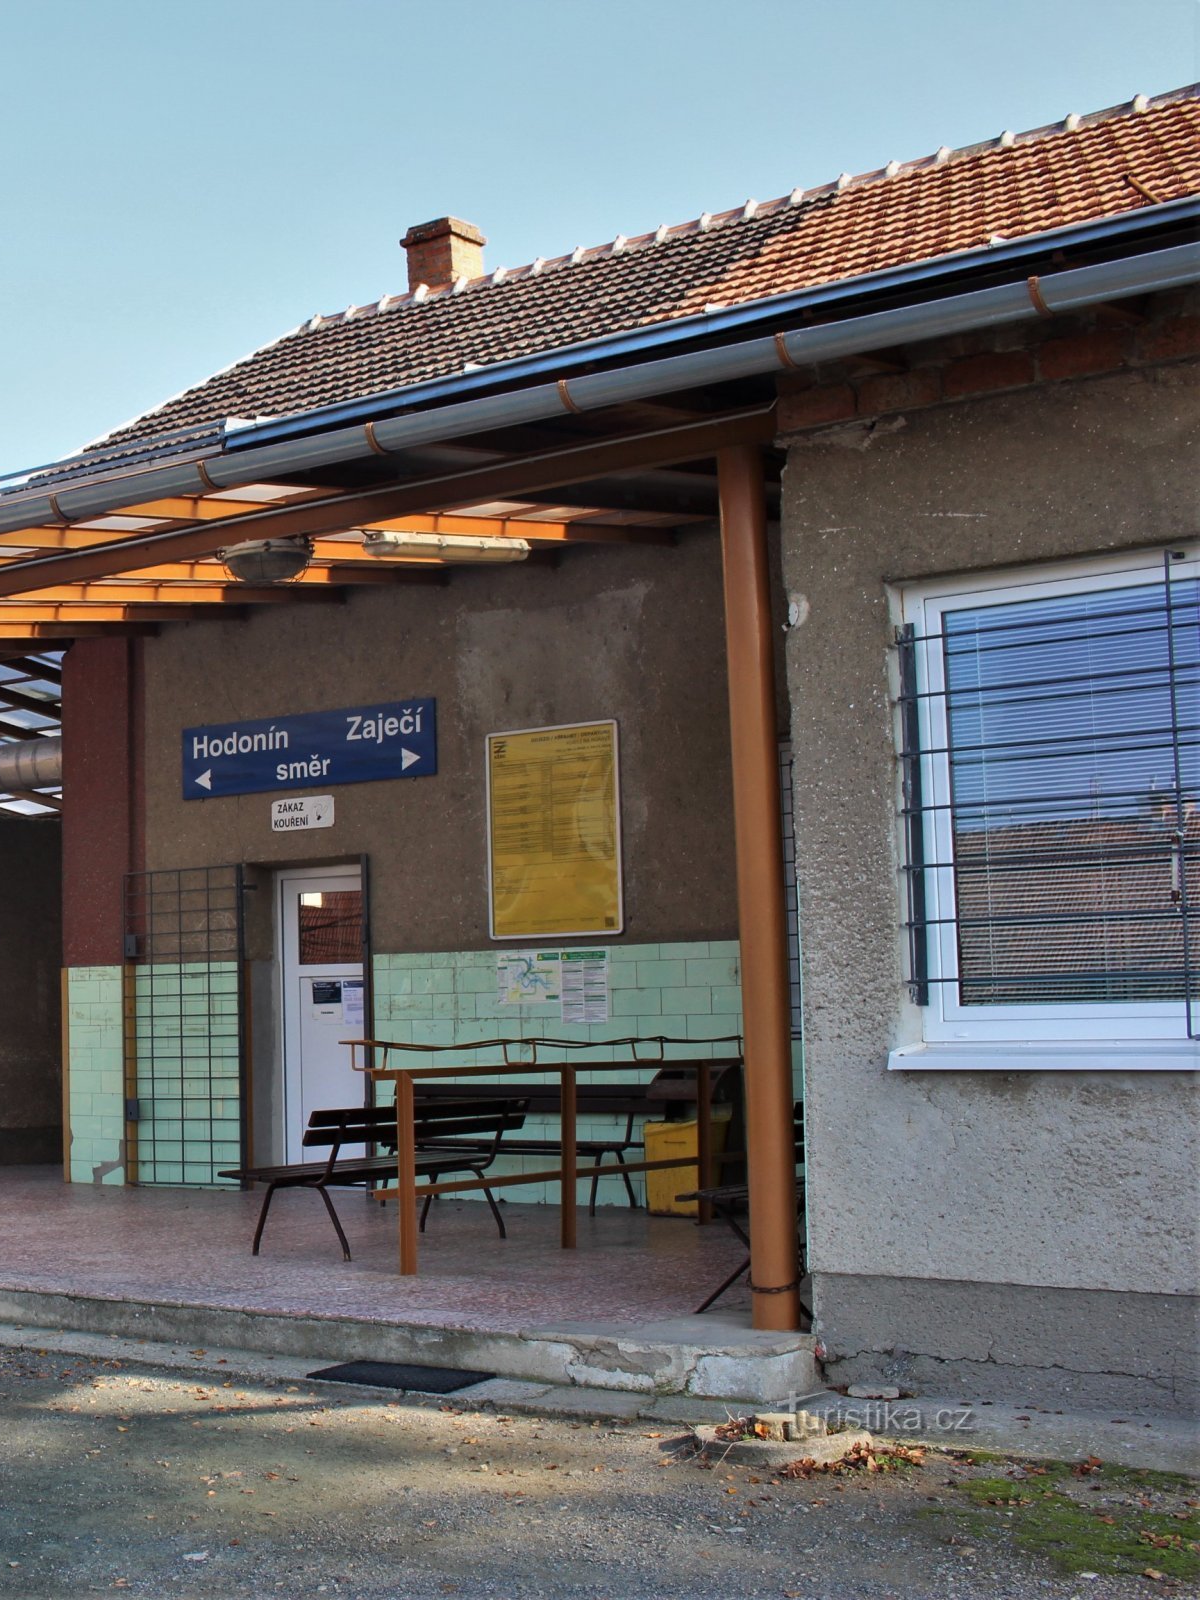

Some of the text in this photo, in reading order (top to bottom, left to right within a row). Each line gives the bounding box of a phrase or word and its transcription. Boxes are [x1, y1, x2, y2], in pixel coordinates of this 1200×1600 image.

[346, 707, 424, 744] Zaječí
[193, 725, 289, 759] Hodonín
[276, 754, 331, 781] směr
[273, 814, 309, 829] KOUŘENÍ
[277, 802, 304, 814] ZÁKAZ
